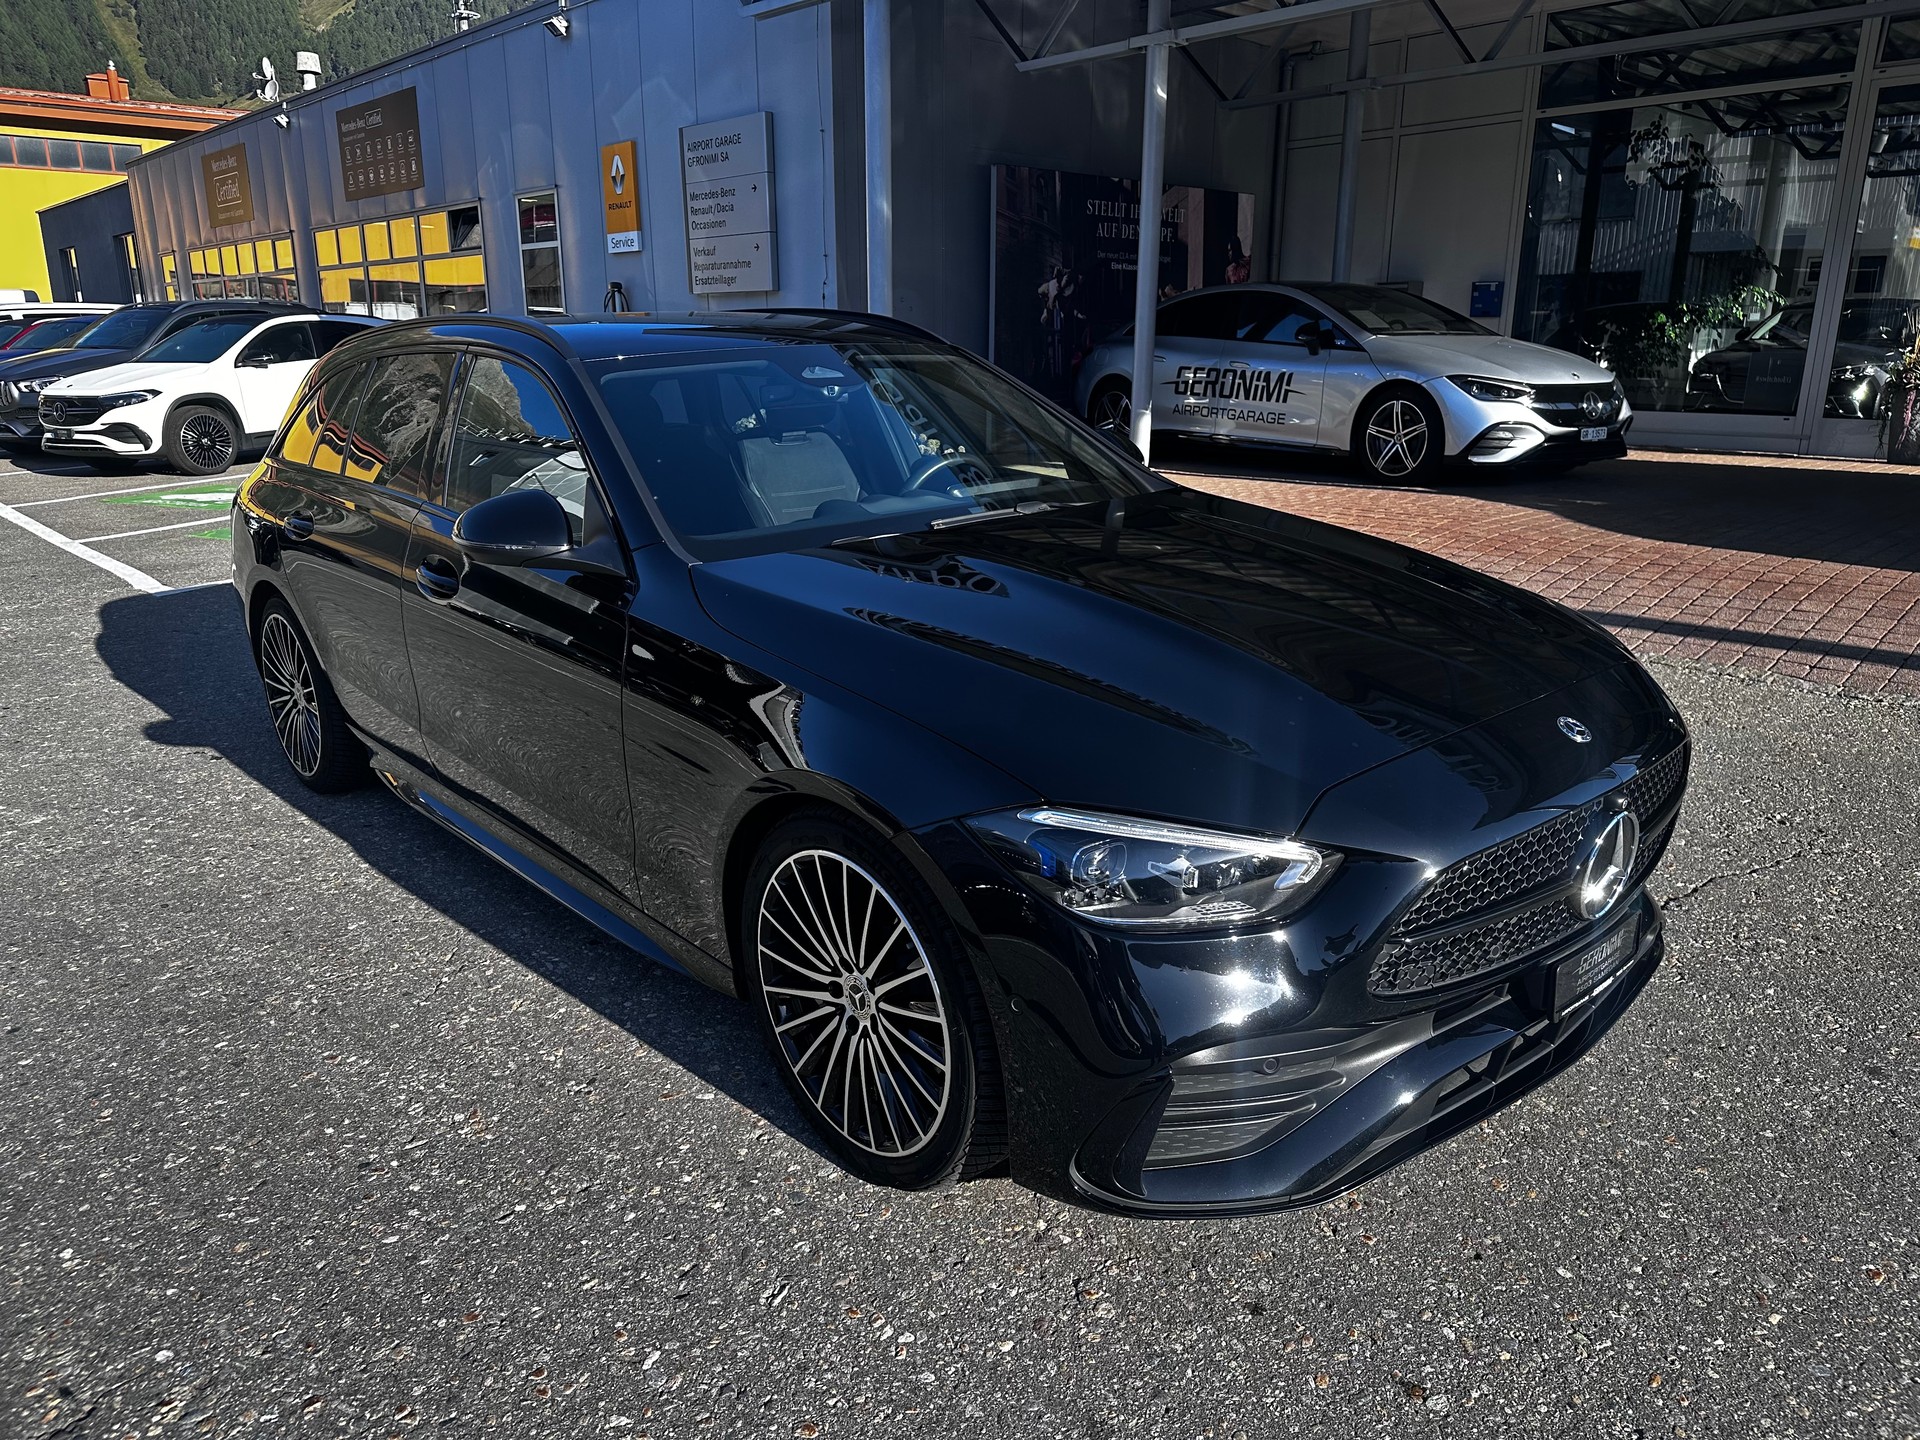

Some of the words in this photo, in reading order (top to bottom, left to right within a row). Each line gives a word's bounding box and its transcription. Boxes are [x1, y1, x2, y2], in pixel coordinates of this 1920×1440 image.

[687, 138, 714, 153] AIRPORT
[715, 133, 742, 148] GARAGE
[720, 152, 730, 163] SA
[215, 176, 241, 202] Certified
[689, 187, 736, 202] Mercedes-Benz
[608, 200, 632, 211] RENAULT
[690, 202, 735, 217] Renault/Dacia
[1086, 198, 1127, 218] STELLT
[691, 218, 727, 231] Occasionen
[1096, 222, 1118, 238] AUF
[611, 236, 635, 249] Service
[693, 245, 716, 257] Verkauf
[693, 258, 752, 275] Reparaturannahme
[694, 274, 737, 287] Ersatzteillager
[1166, 366, 1302, 403] GERONIMI
[1172, 403, 1287, 426] AIRPORTGARAGE
